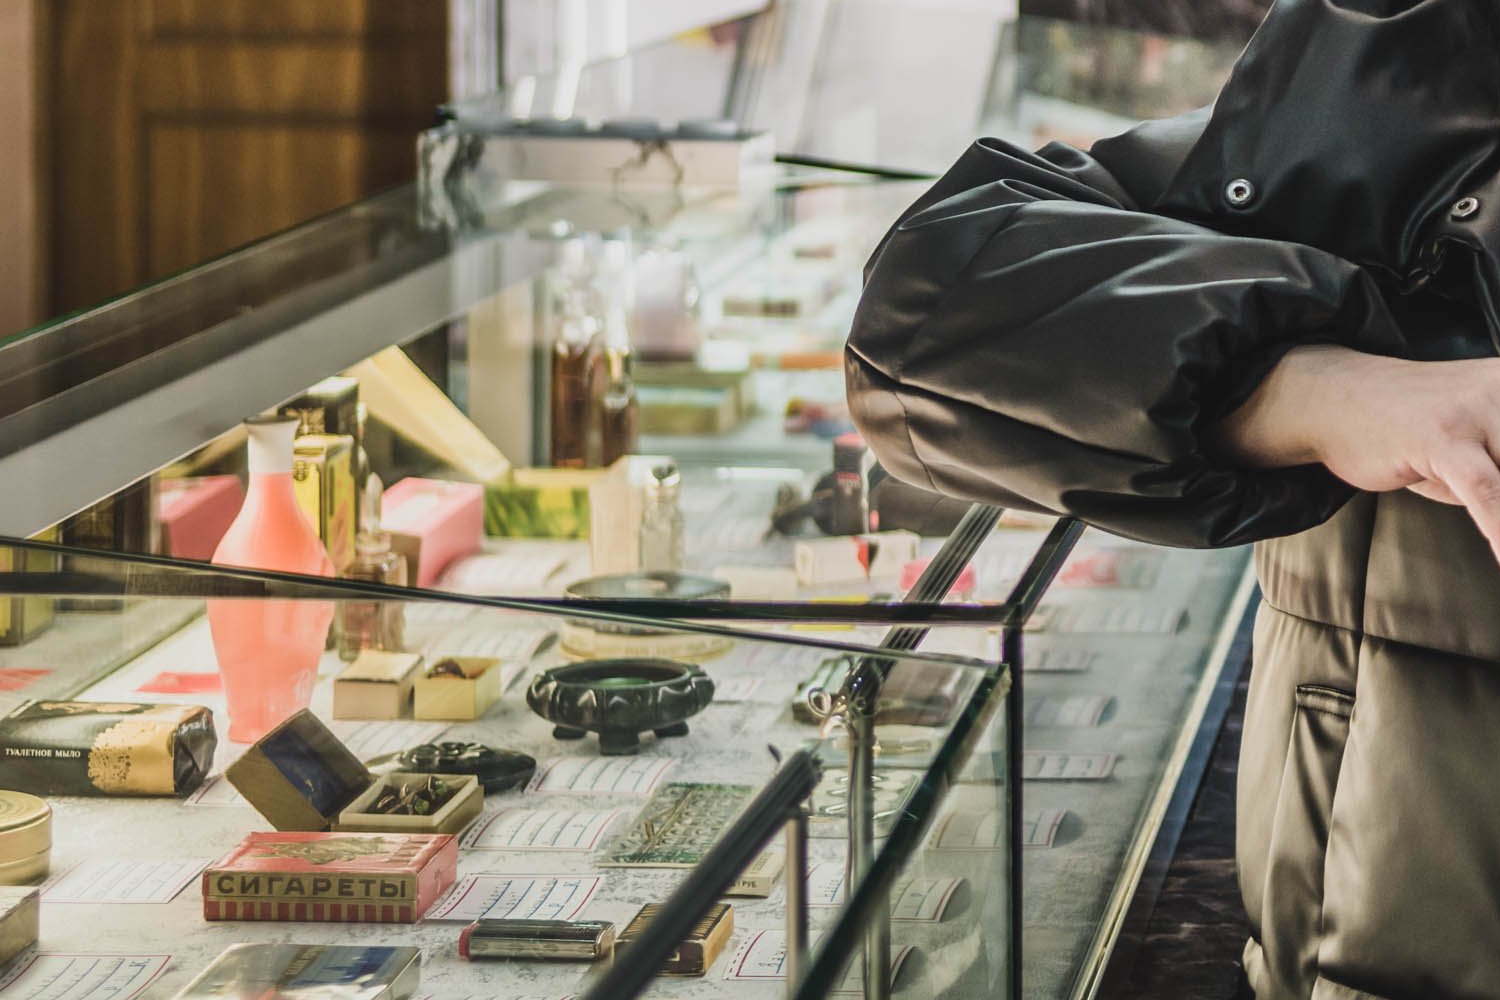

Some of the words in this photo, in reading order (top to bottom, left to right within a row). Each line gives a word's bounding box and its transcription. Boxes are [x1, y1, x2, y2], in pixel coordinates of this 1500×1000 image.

[5, 747, 52, 758] ТУАЛЕТНОЕ
[55, 749, 81, 759] МЫЛО
[216, 875, 406, 898] СИГАРЕТЫ
